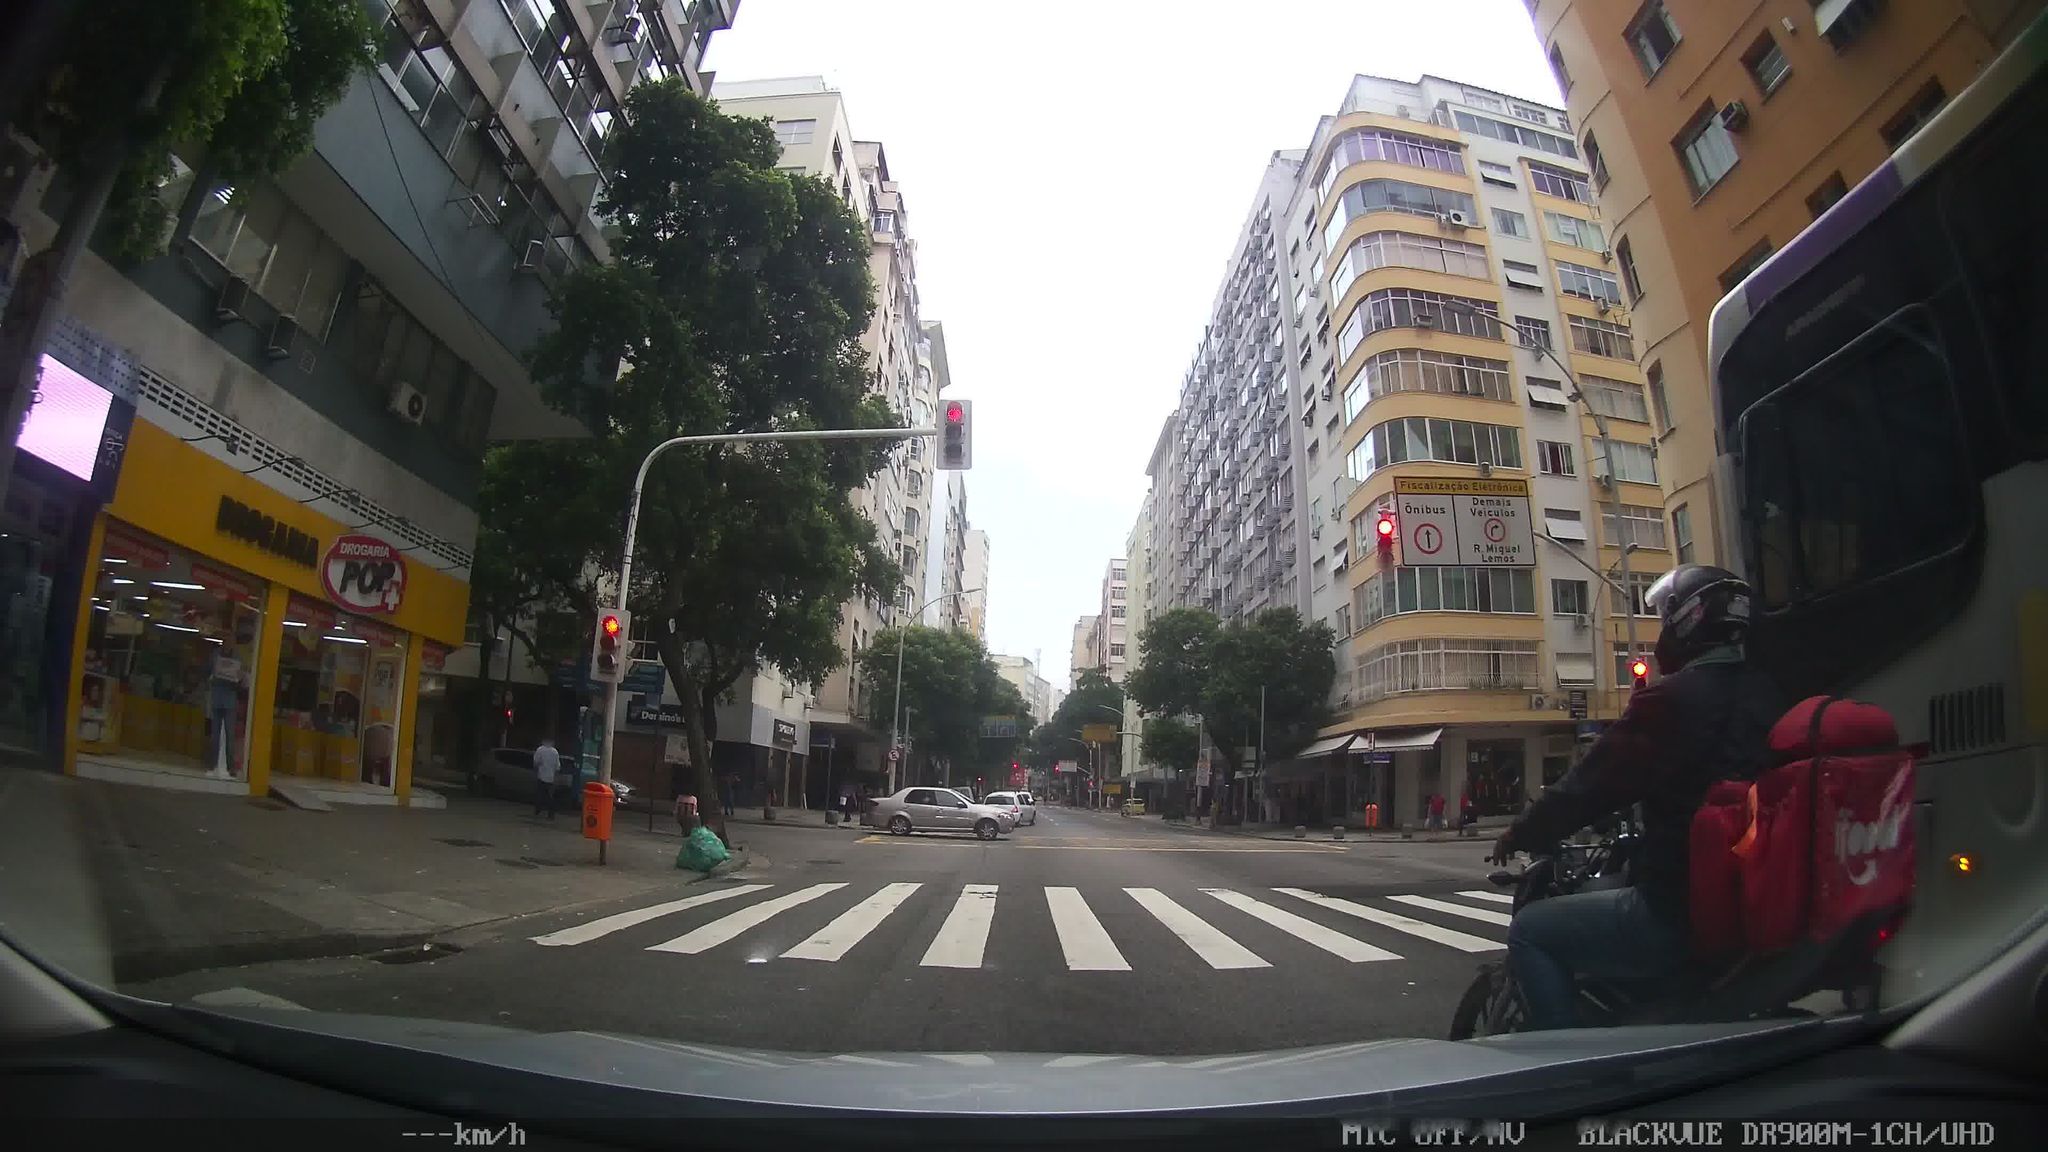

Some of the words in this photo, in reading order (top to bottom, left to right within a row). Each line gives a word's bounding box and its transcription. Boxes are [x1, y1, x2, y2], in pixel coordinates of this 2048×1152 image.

[1400, 480, 1468, 492] Fiscalização
[1472, 481, 1524, 492] Eletrônica
[1472, 497, 1511, 507] Demais
[1404, 502, 1446, 515] Ônibus
[339, 541, 391, 560] DROGARIA
[1473, 544, 1484, 554] R.
[1486, 543, 1521, 556] Miguel
[1481, 554, 1516, 564] Lemos
